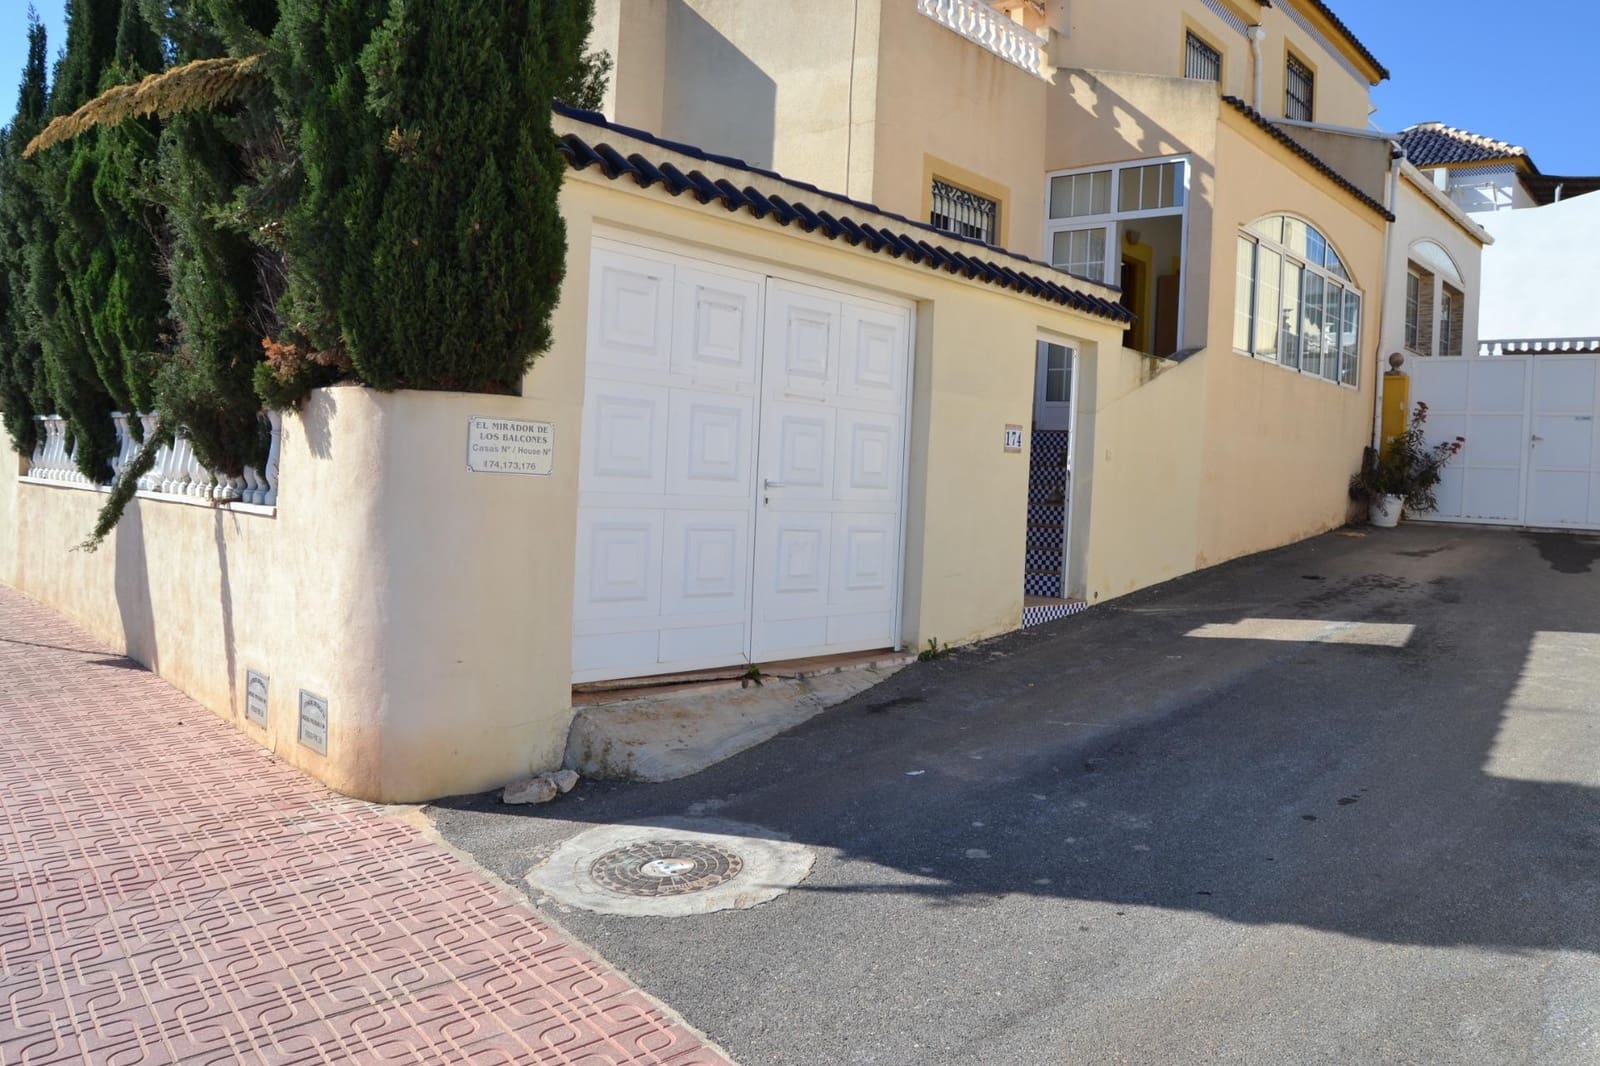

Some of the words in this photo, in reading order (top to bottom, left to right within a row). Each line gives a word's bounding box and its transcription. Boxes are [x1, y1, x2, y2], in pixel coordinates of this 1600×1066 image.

[476, 421, 488, 430] EL
[492, 422, 534, 433] MIRADOR
[537, 425, 549, 433] DE
[480, 432, 500, 441] LOS
[502, 433, 548, 444] BALCONES
[1006, 431, 1021, 447] 174
[472, 443, 499, 452] Casas
[518, 446, 541, 455] House
